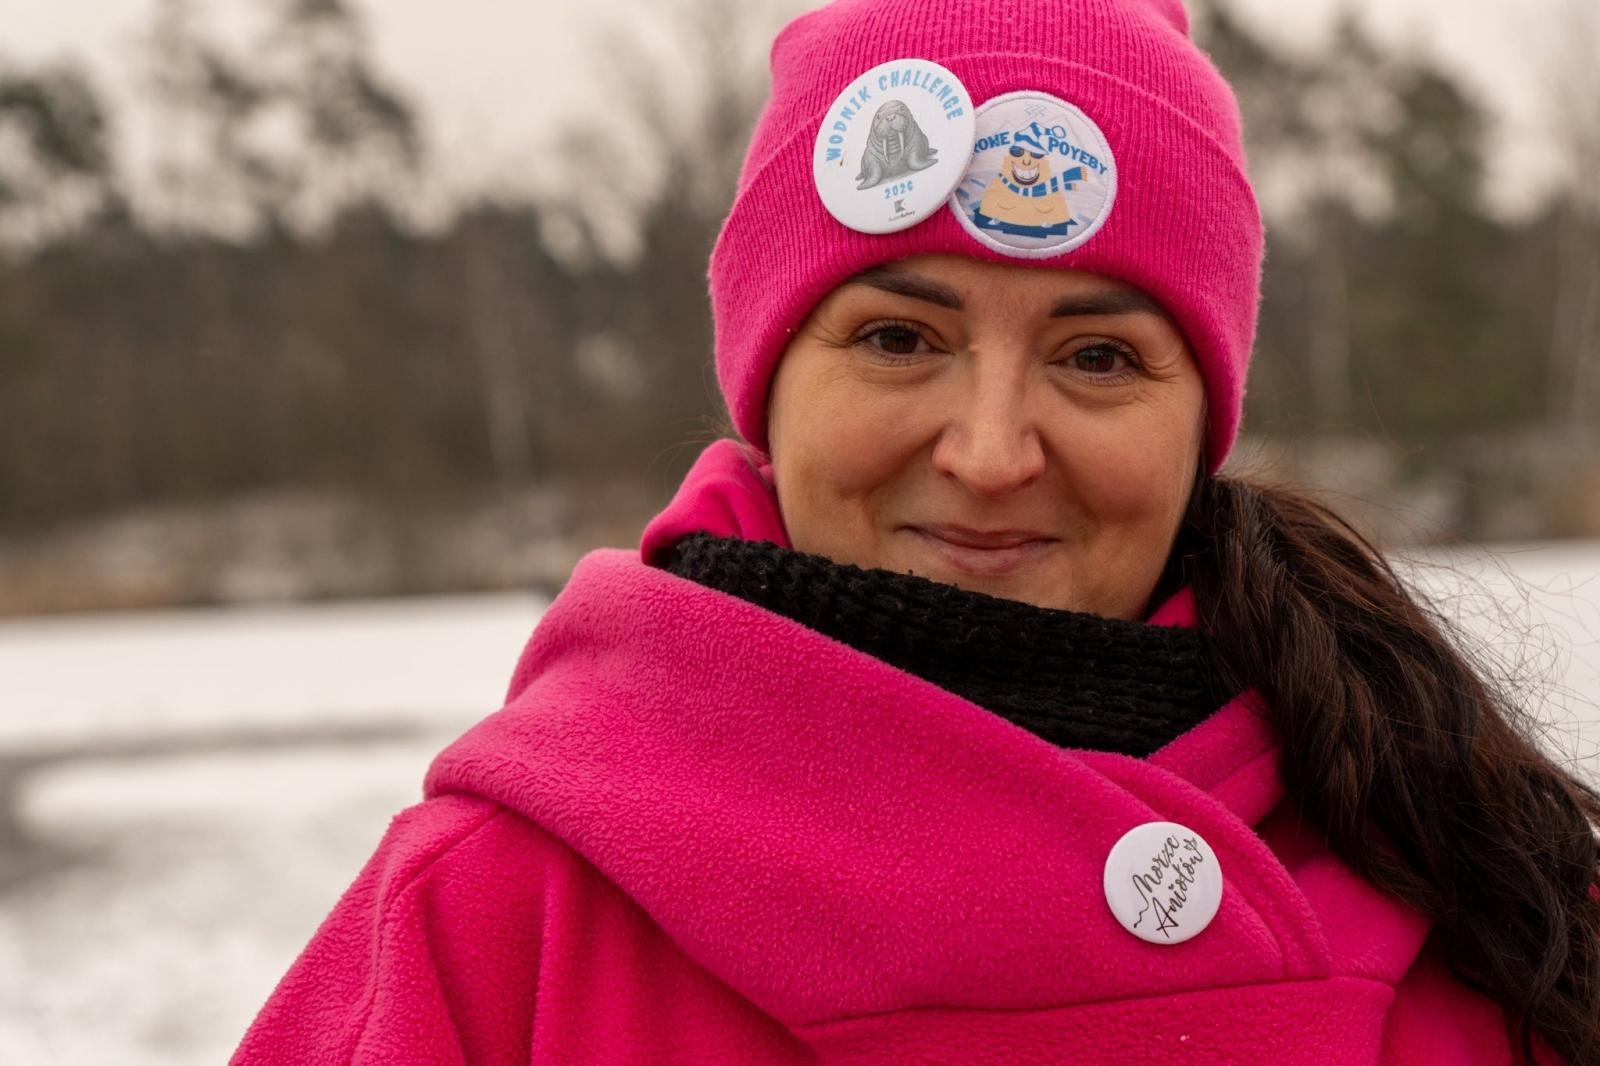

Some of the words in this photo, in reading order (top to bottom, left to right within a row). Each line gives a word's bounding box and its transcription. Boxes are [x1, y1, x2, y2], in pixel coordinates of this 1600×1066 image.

[826, 86, 871, 161] WODNIK
[878, 70, 964, 120] CHALLENGE
[1049, 137, 1108, 175] POYEBY
[884, 180, 913, 199] 2026
[1132, 835, 1180, 928] Morze
